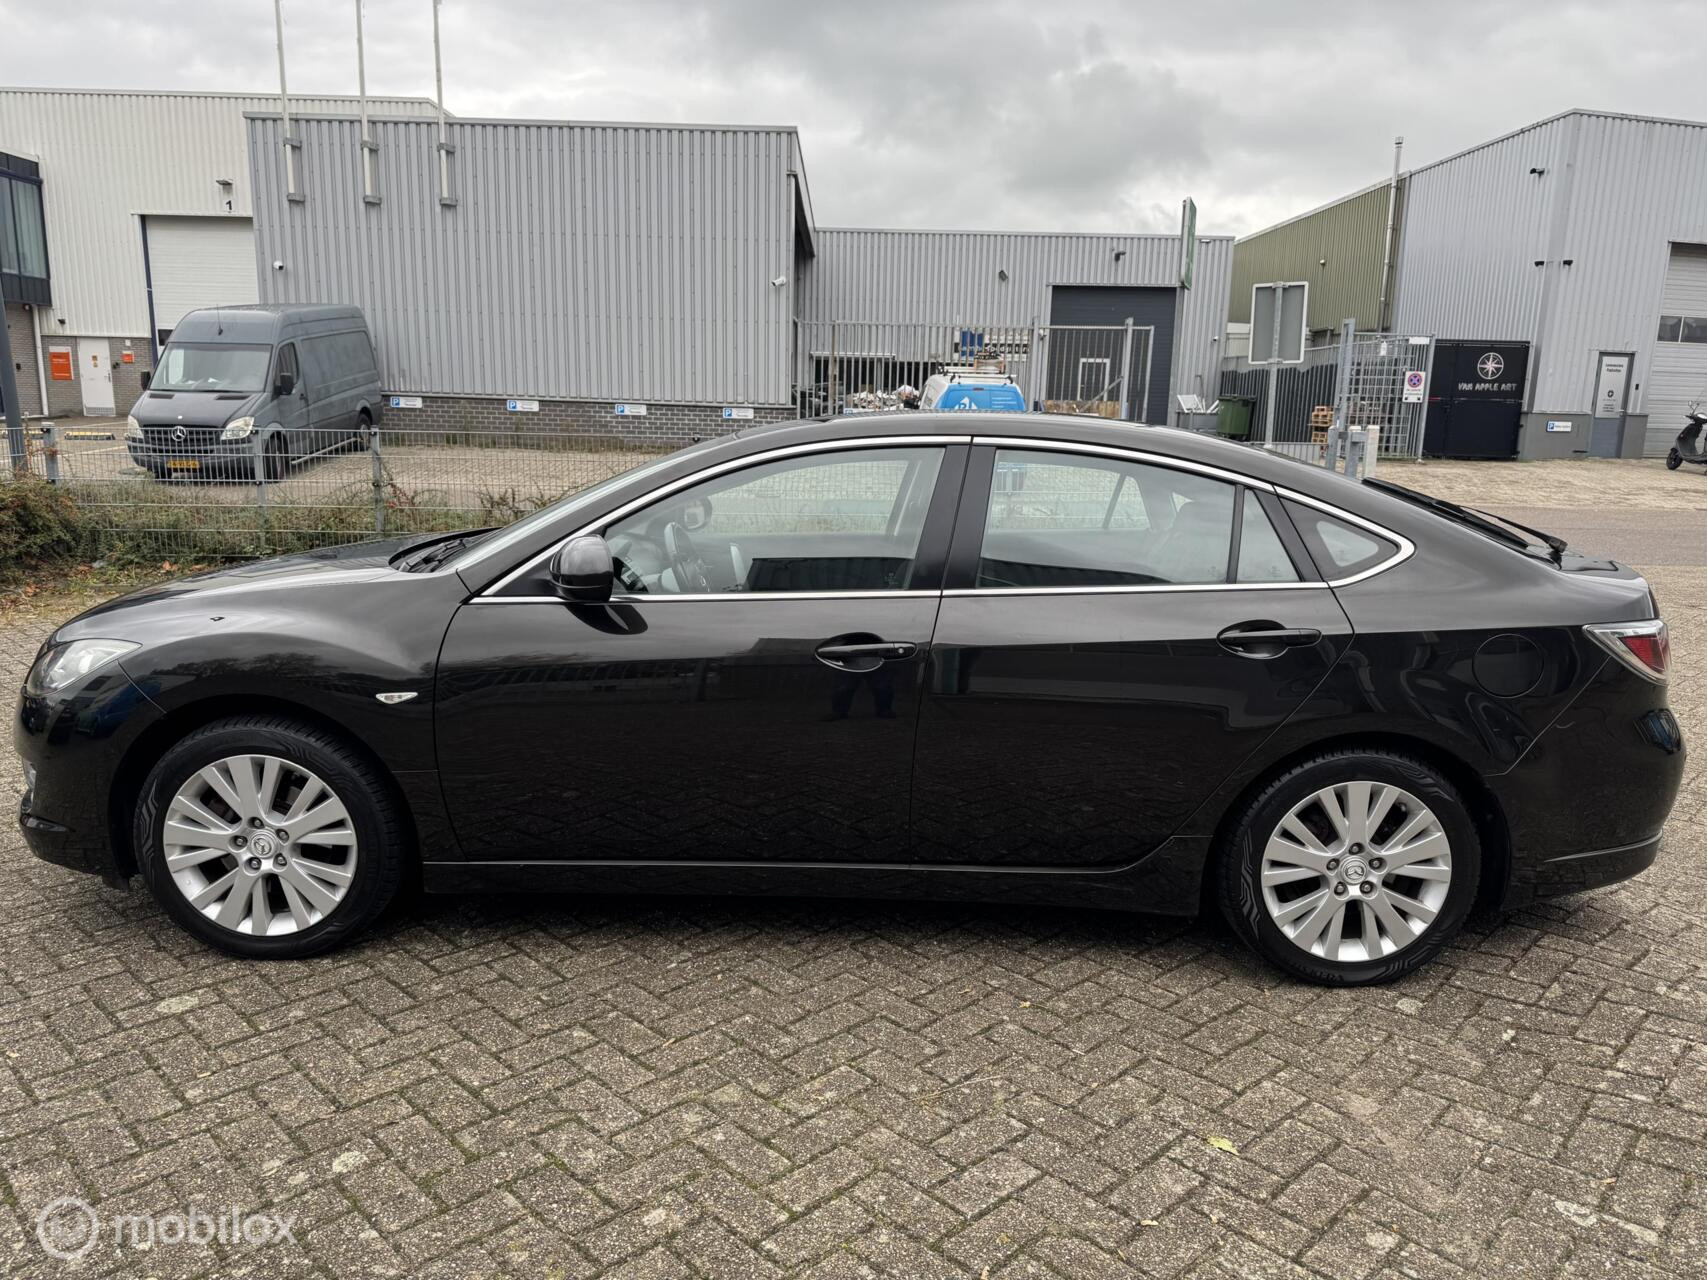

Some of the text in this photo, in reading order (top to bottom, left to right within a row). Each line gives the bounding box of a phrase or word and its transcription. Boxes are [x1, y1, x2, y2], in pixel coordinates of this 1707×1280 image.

[226, 200, 232, 210] 1
[1458, 383, 1517, 391] VAN APPLE ART
